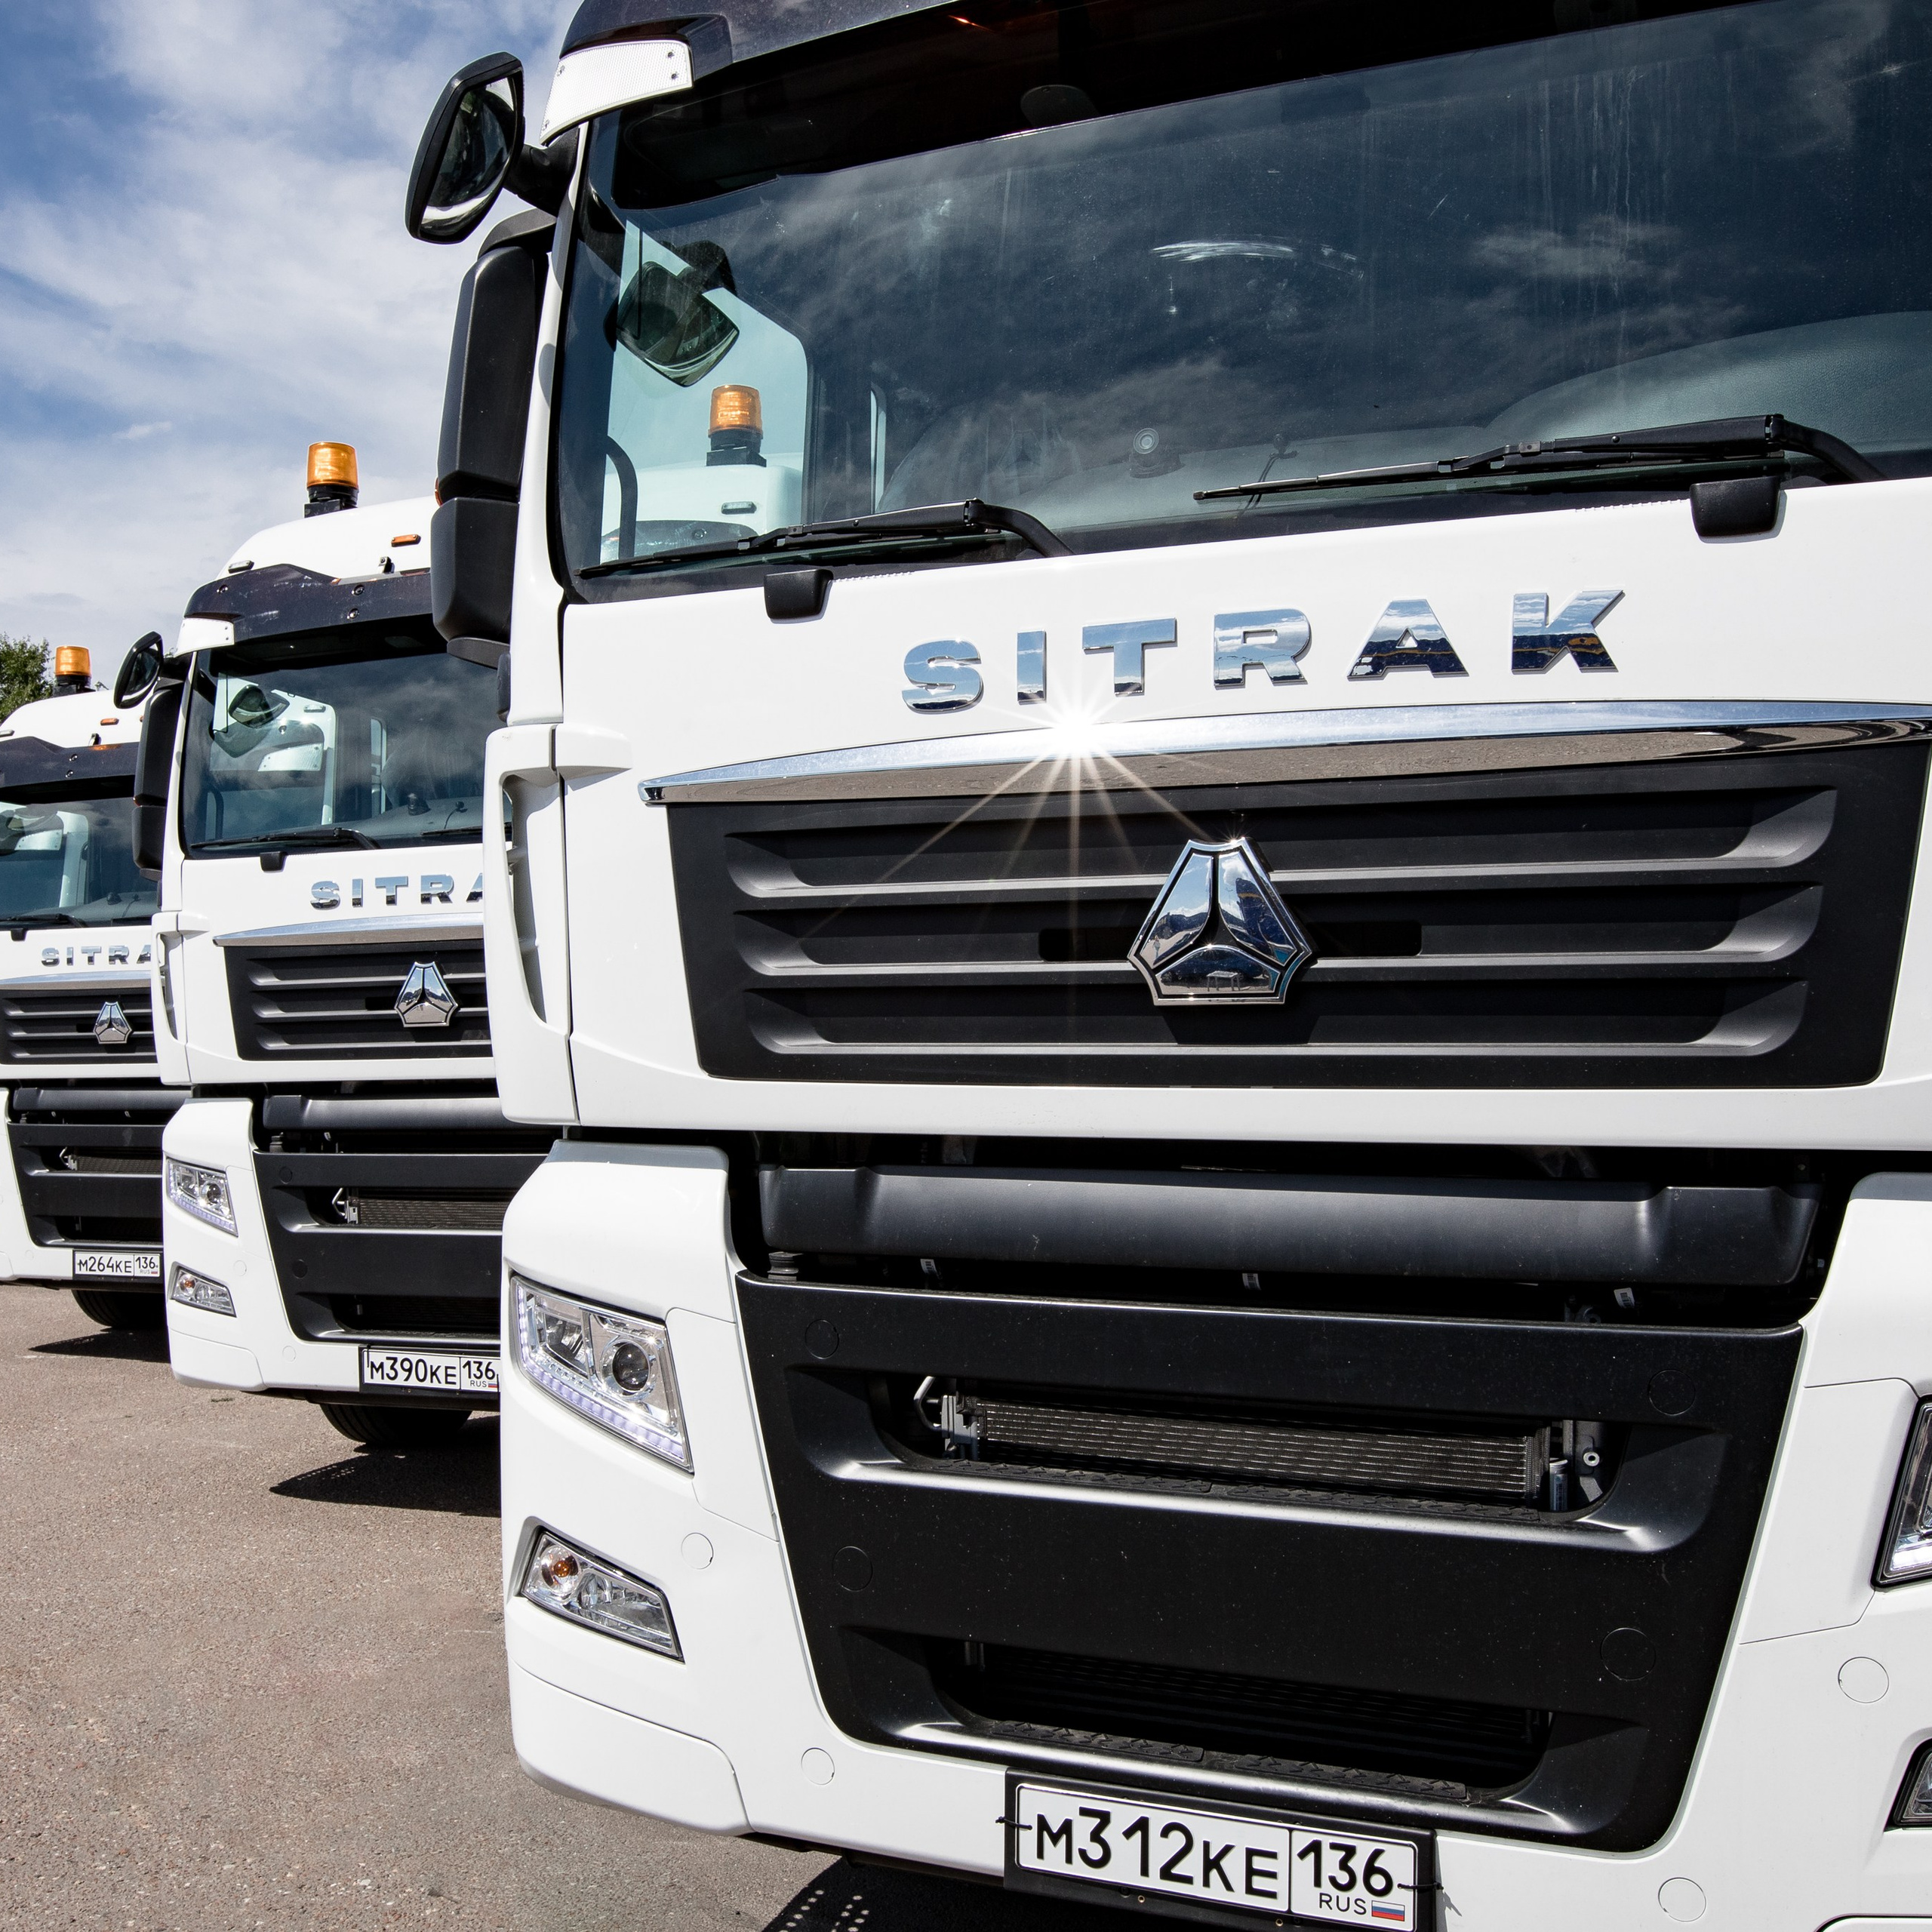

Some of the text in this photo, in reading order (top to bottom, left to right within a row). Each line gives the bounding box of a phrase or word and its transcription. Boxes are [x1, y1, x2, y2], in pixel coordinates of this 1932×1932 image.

[902, 589, 1625, 713] SITRAK
[78, 1256, 155, 1273] M264KE 136
[370, 1356, 496, 1385] M390KE 136
[1036, 1806, 1395, 1900] M312KE 136
[1318, 1893, 1367, 1915] RUS
